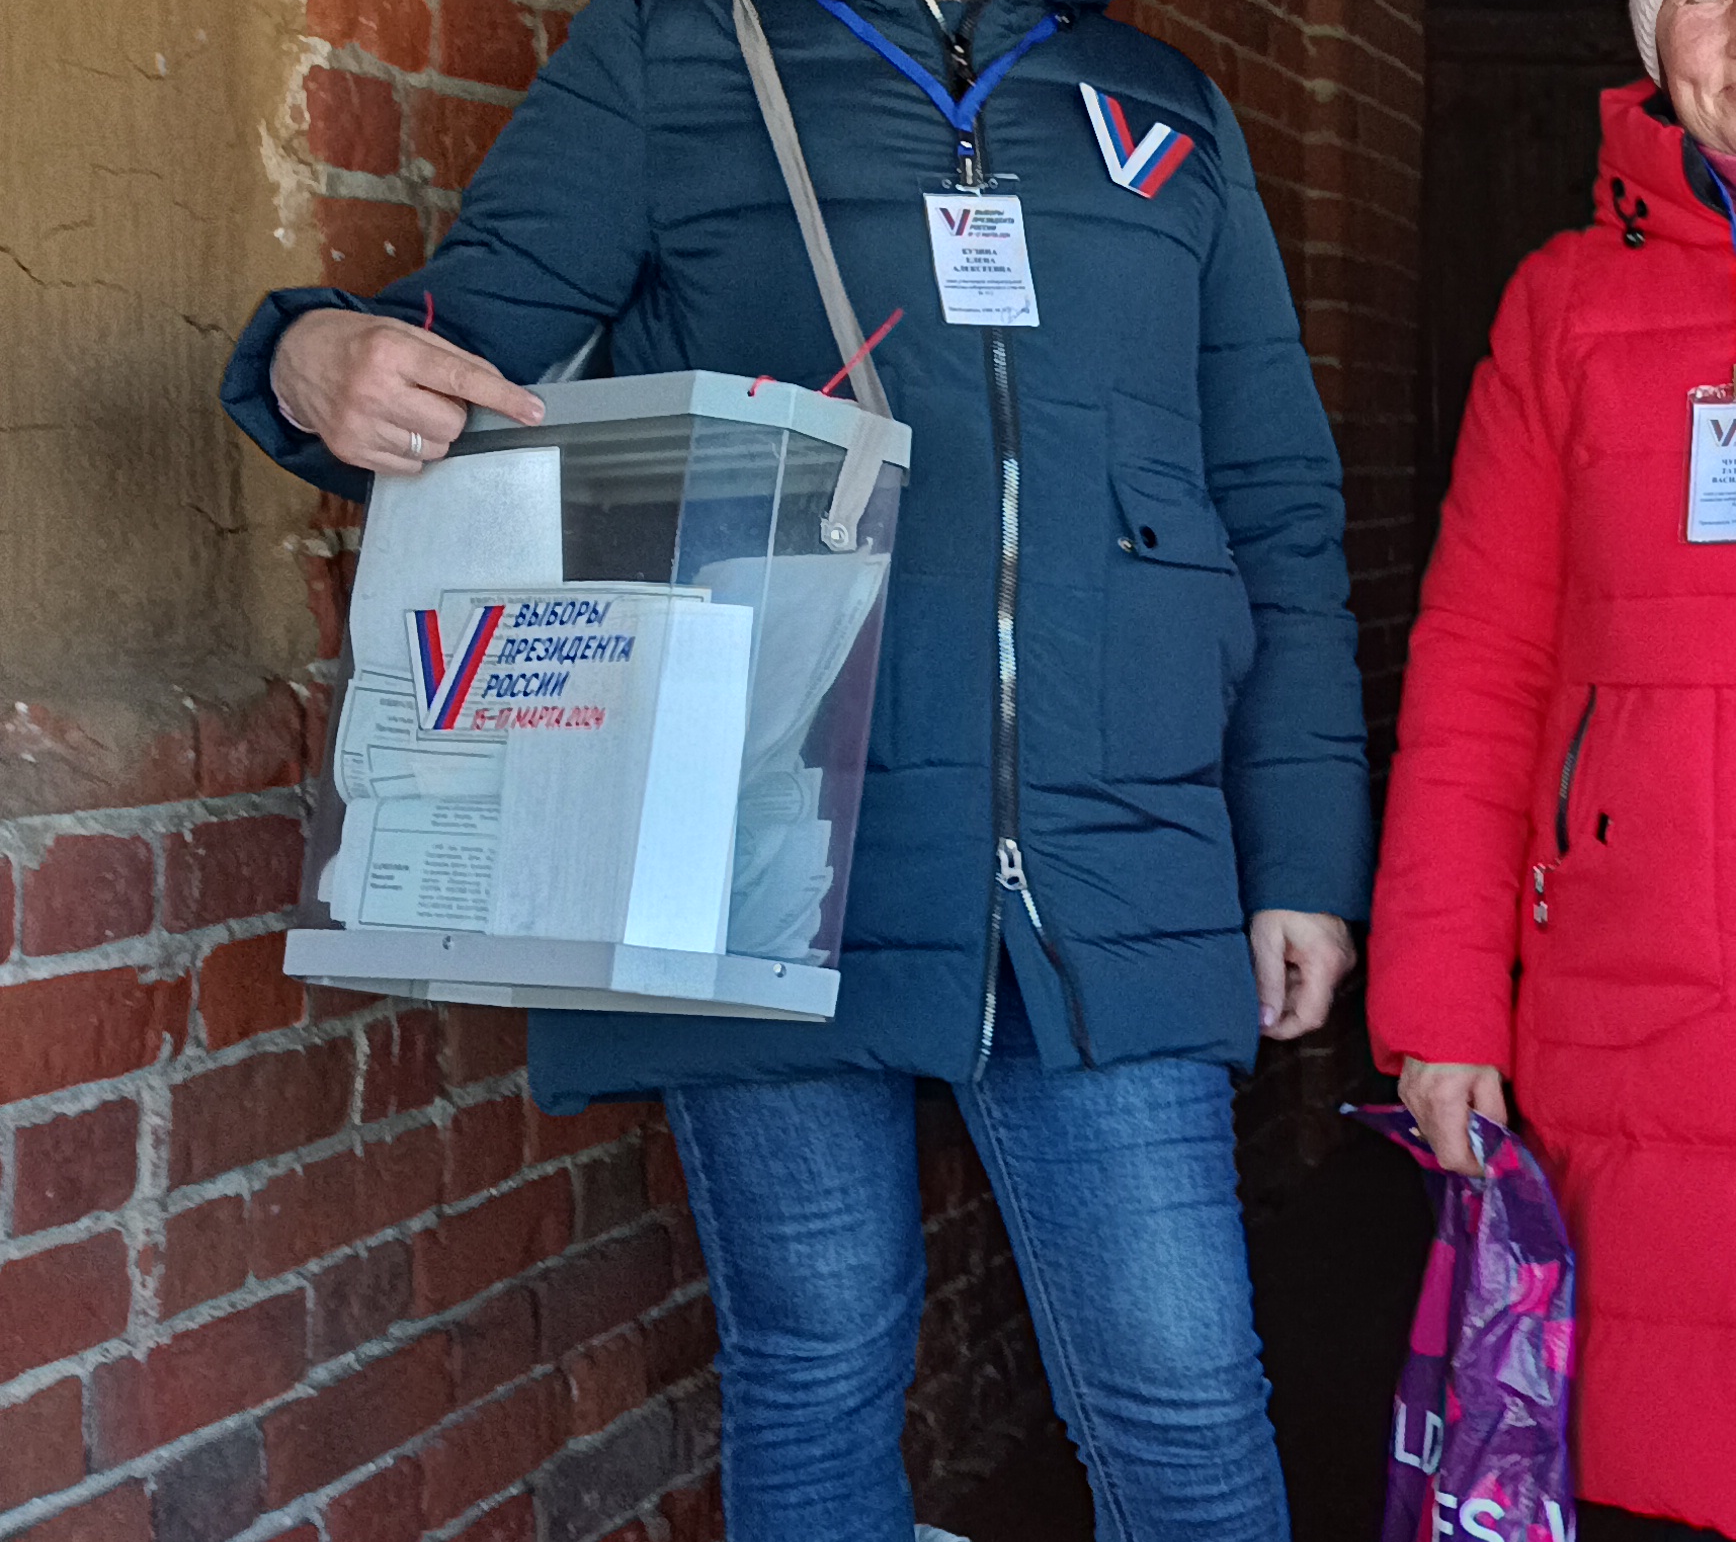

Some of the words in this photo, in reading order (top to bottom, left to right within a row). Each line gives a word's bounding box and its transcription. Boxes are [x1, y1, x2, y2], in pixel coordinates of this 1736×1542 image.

[513, 600, 612, 628] ВЫБОРЫ
[497, 635, 636, 665] ПРЕЗИДЕНТА
[481, 671, 570, 699] РОССИИ
